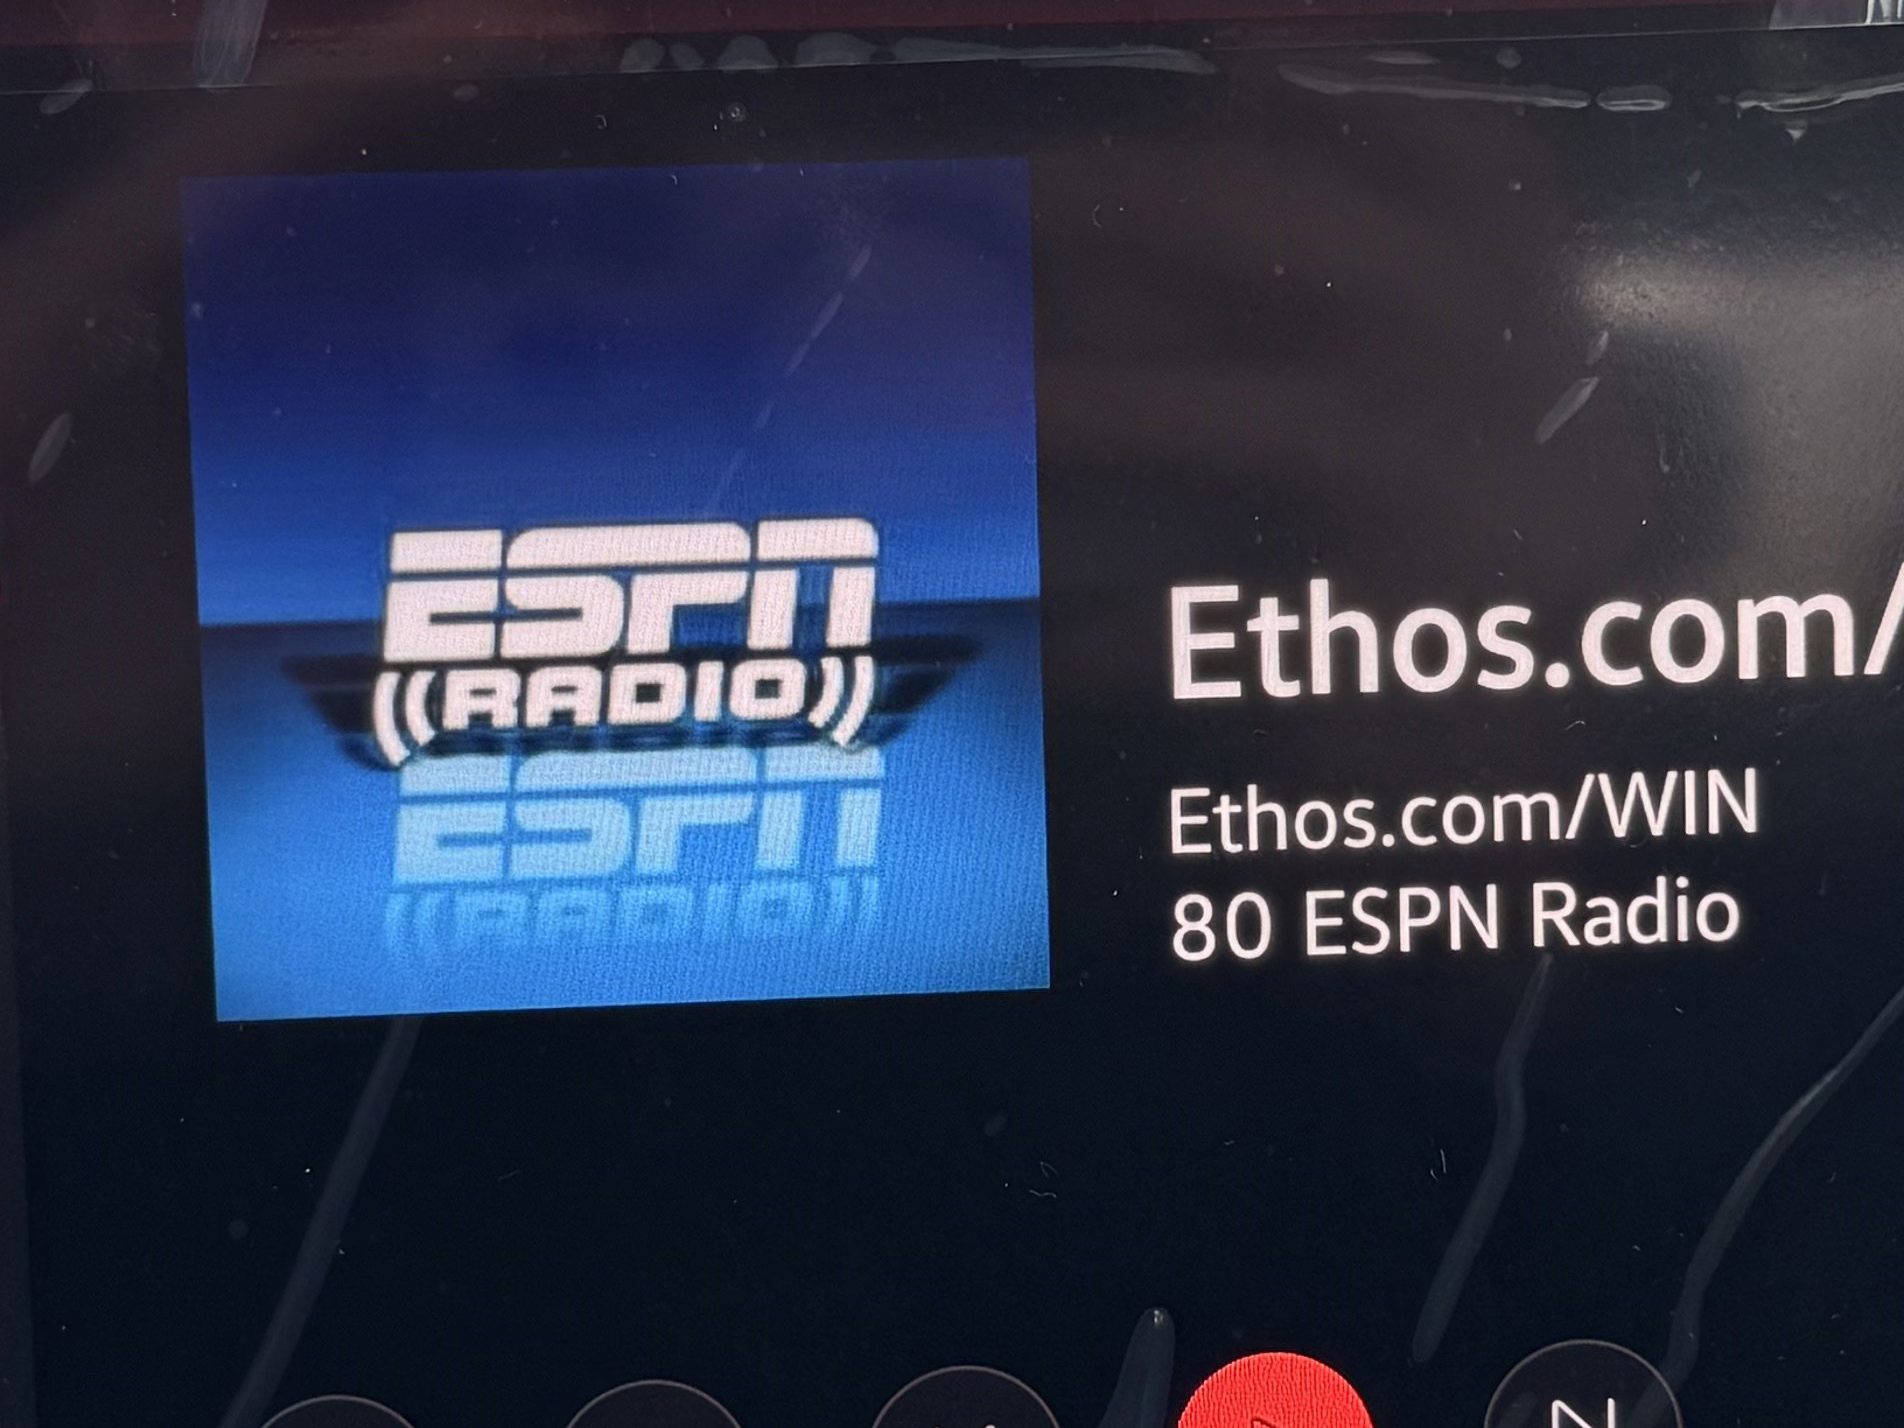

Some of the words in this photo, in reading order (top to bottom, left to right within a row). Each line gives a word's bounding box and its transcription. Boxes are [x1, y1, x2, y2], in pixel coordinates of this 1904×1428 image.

[382, 518, 880, 663] ESPN
[392, 747, 886, 883] ESPN
[1171, 768, 1756, 853] Ethos.com/WIN
[1173, 892, 1271, 961] 80
[1306, 884, 1498, 955] ESPN
[1533, 876, 1739, 947] Radio
